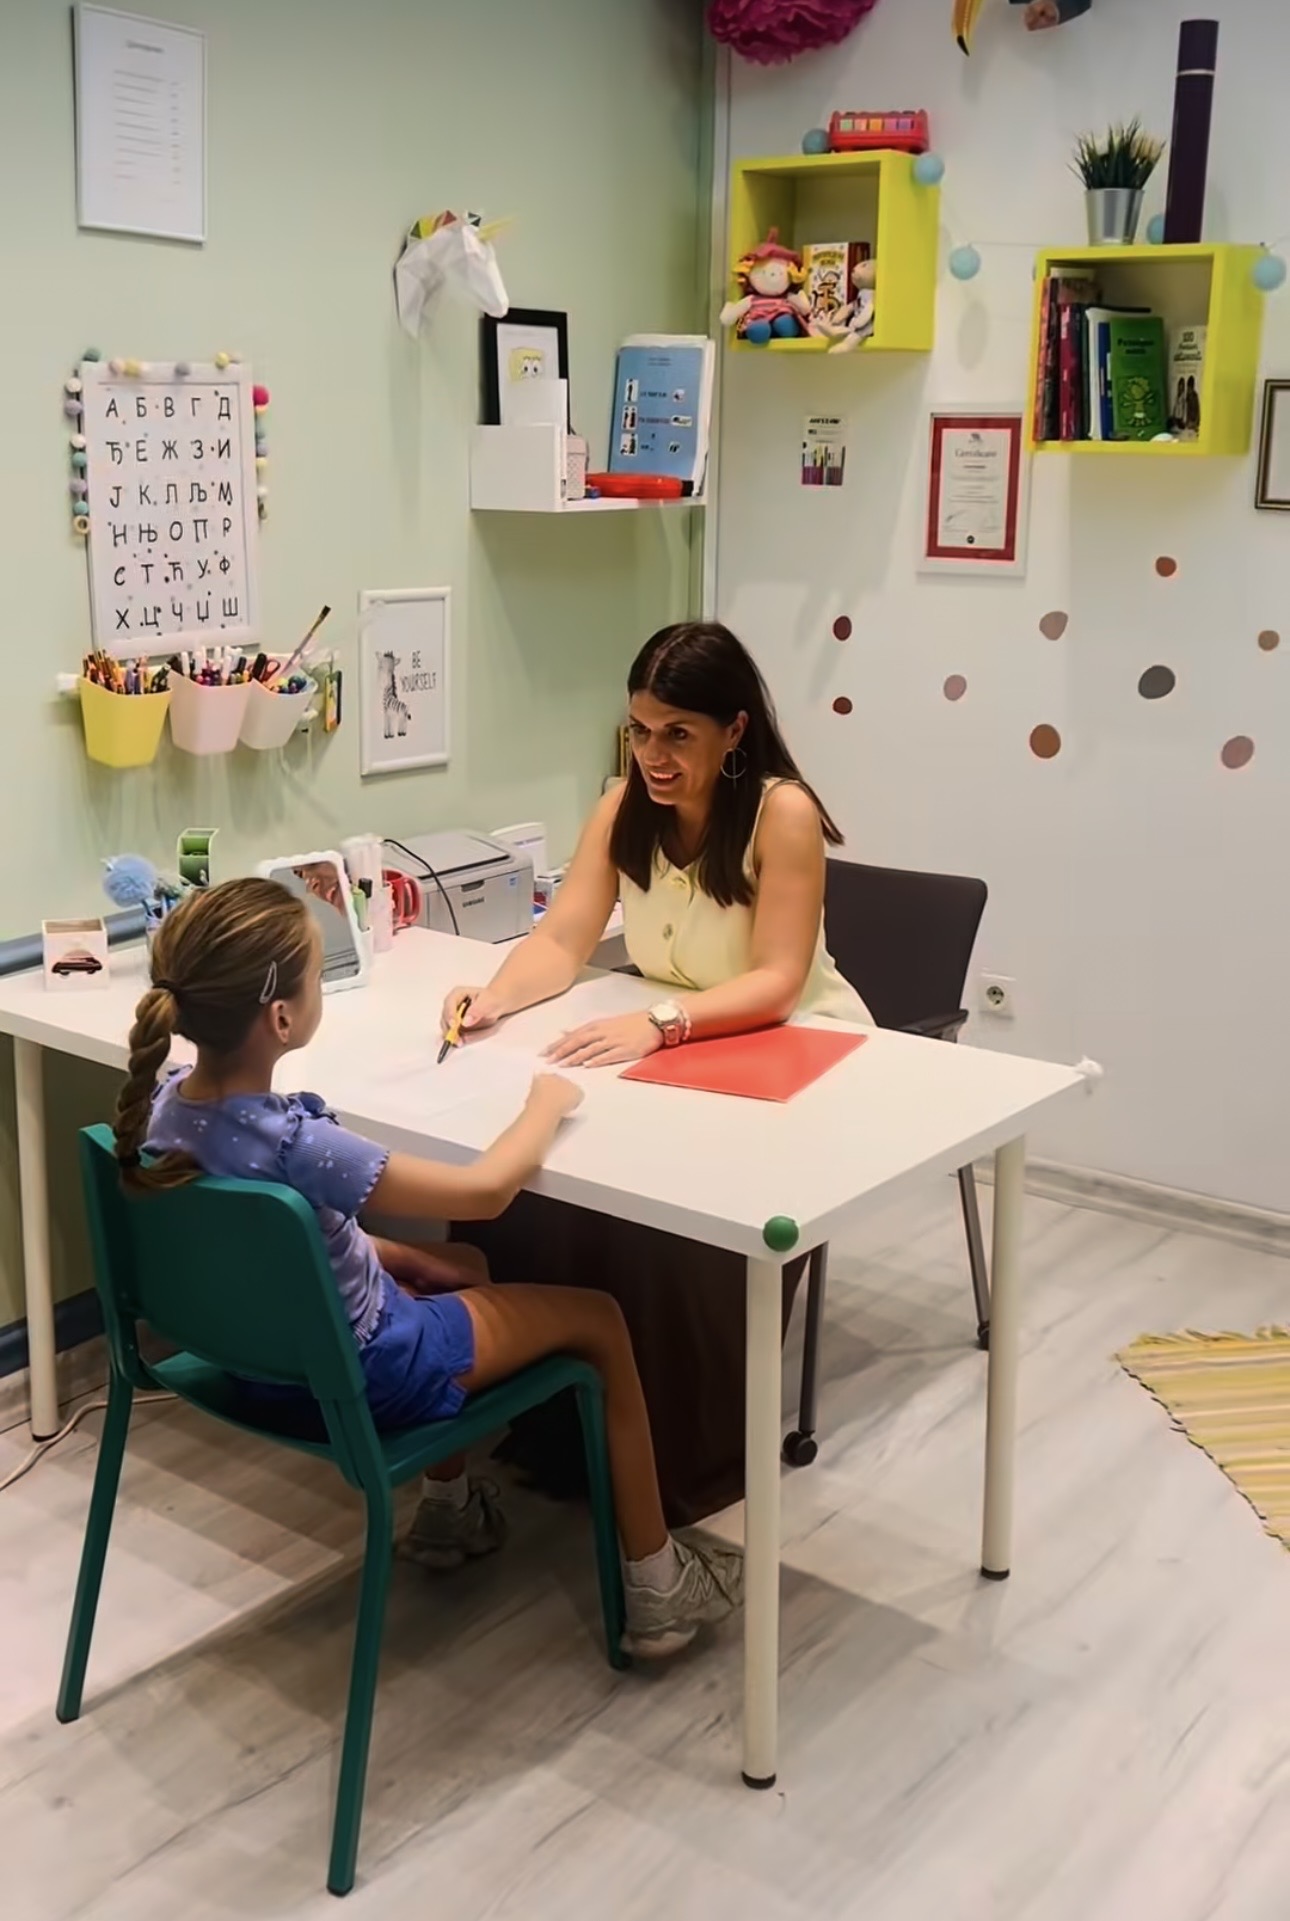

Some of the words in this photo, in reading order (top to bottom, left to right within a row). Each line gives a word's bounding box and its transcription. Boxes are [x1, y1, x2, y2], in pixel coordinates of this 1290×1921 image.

[106, 398, 118, 418] А
[136, 397, 147, 417] Б
[164, 397, 175, 417] В
[191, 398, 201, 416] Г
[218, 397, 231, 420] Д
[106, 441, 123, 465] Ђ
[136, 440, 147, 461] Е
[162, 440, 178, 460] Ж
[191, 439, 203, 459] З
[218, 438, 231, 459] И
[110, 486, 122, 508] Ј
[139, 484, 151, 505] К
[166, 484, 178, 504] Л
[189, 482, 207, 503] Љ
[113, 524, 127, 547] Н
[139, 523, 158, 543] Њ
[169, 521, 183, 541] О
[193, 519, 208, 543] П
[114, 566, 125, 586] С
[141, 564, 154, 584] Т
[197, 559, 208, 579] У
[219, 556, 230, 575] Ф
[116, 608, 129, 629] Х
[172, 602, 183, 622] Ч
[223, 597, 238, 617] Ш
[412, 650, 421, 668] BE
[401, 672, 437, 693] YOURSELF
